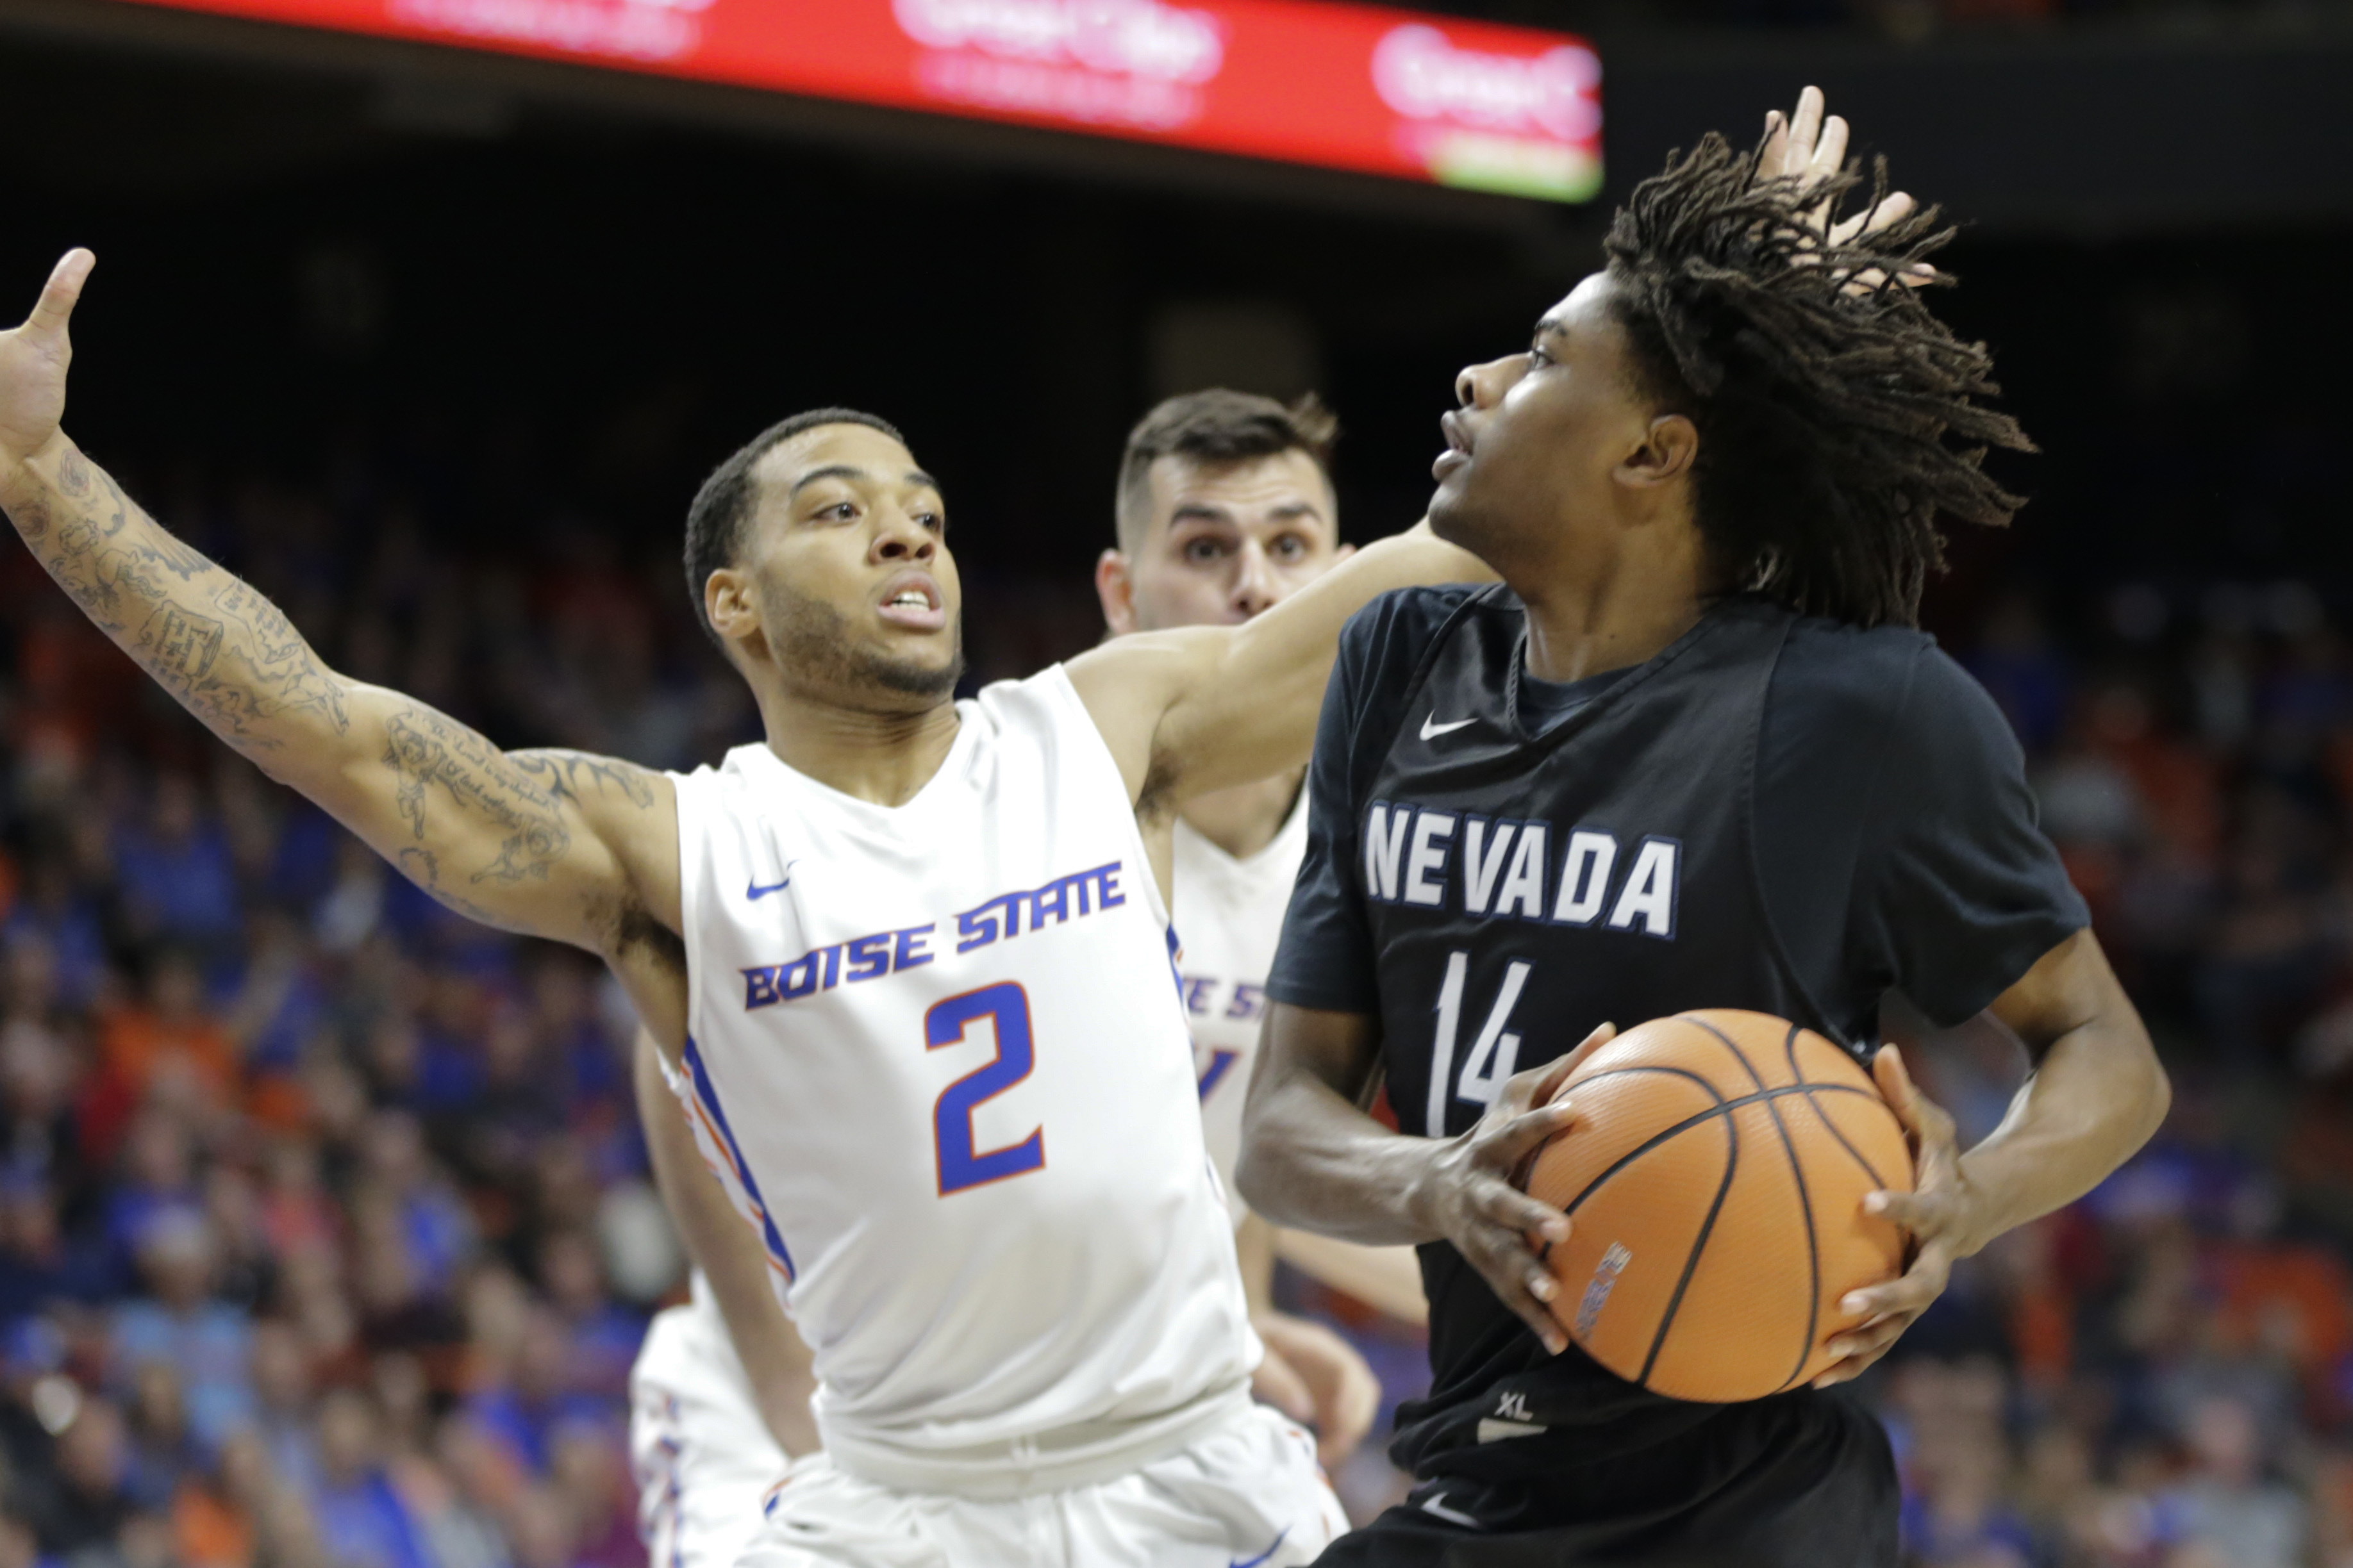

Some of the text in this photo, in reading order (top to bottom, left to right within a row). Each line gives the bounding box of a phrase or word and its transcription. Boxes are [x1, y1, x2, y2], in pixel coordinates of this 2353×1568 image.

[738, 859, 1126, 1011] BOISE STATE
[1364, 800, 1682, 941] NEVADA
[924, 979, 1046, 1198] 2
[1426, 948, 1534, 1138] 14
[1494, 1391, 1534, 1421] XL
